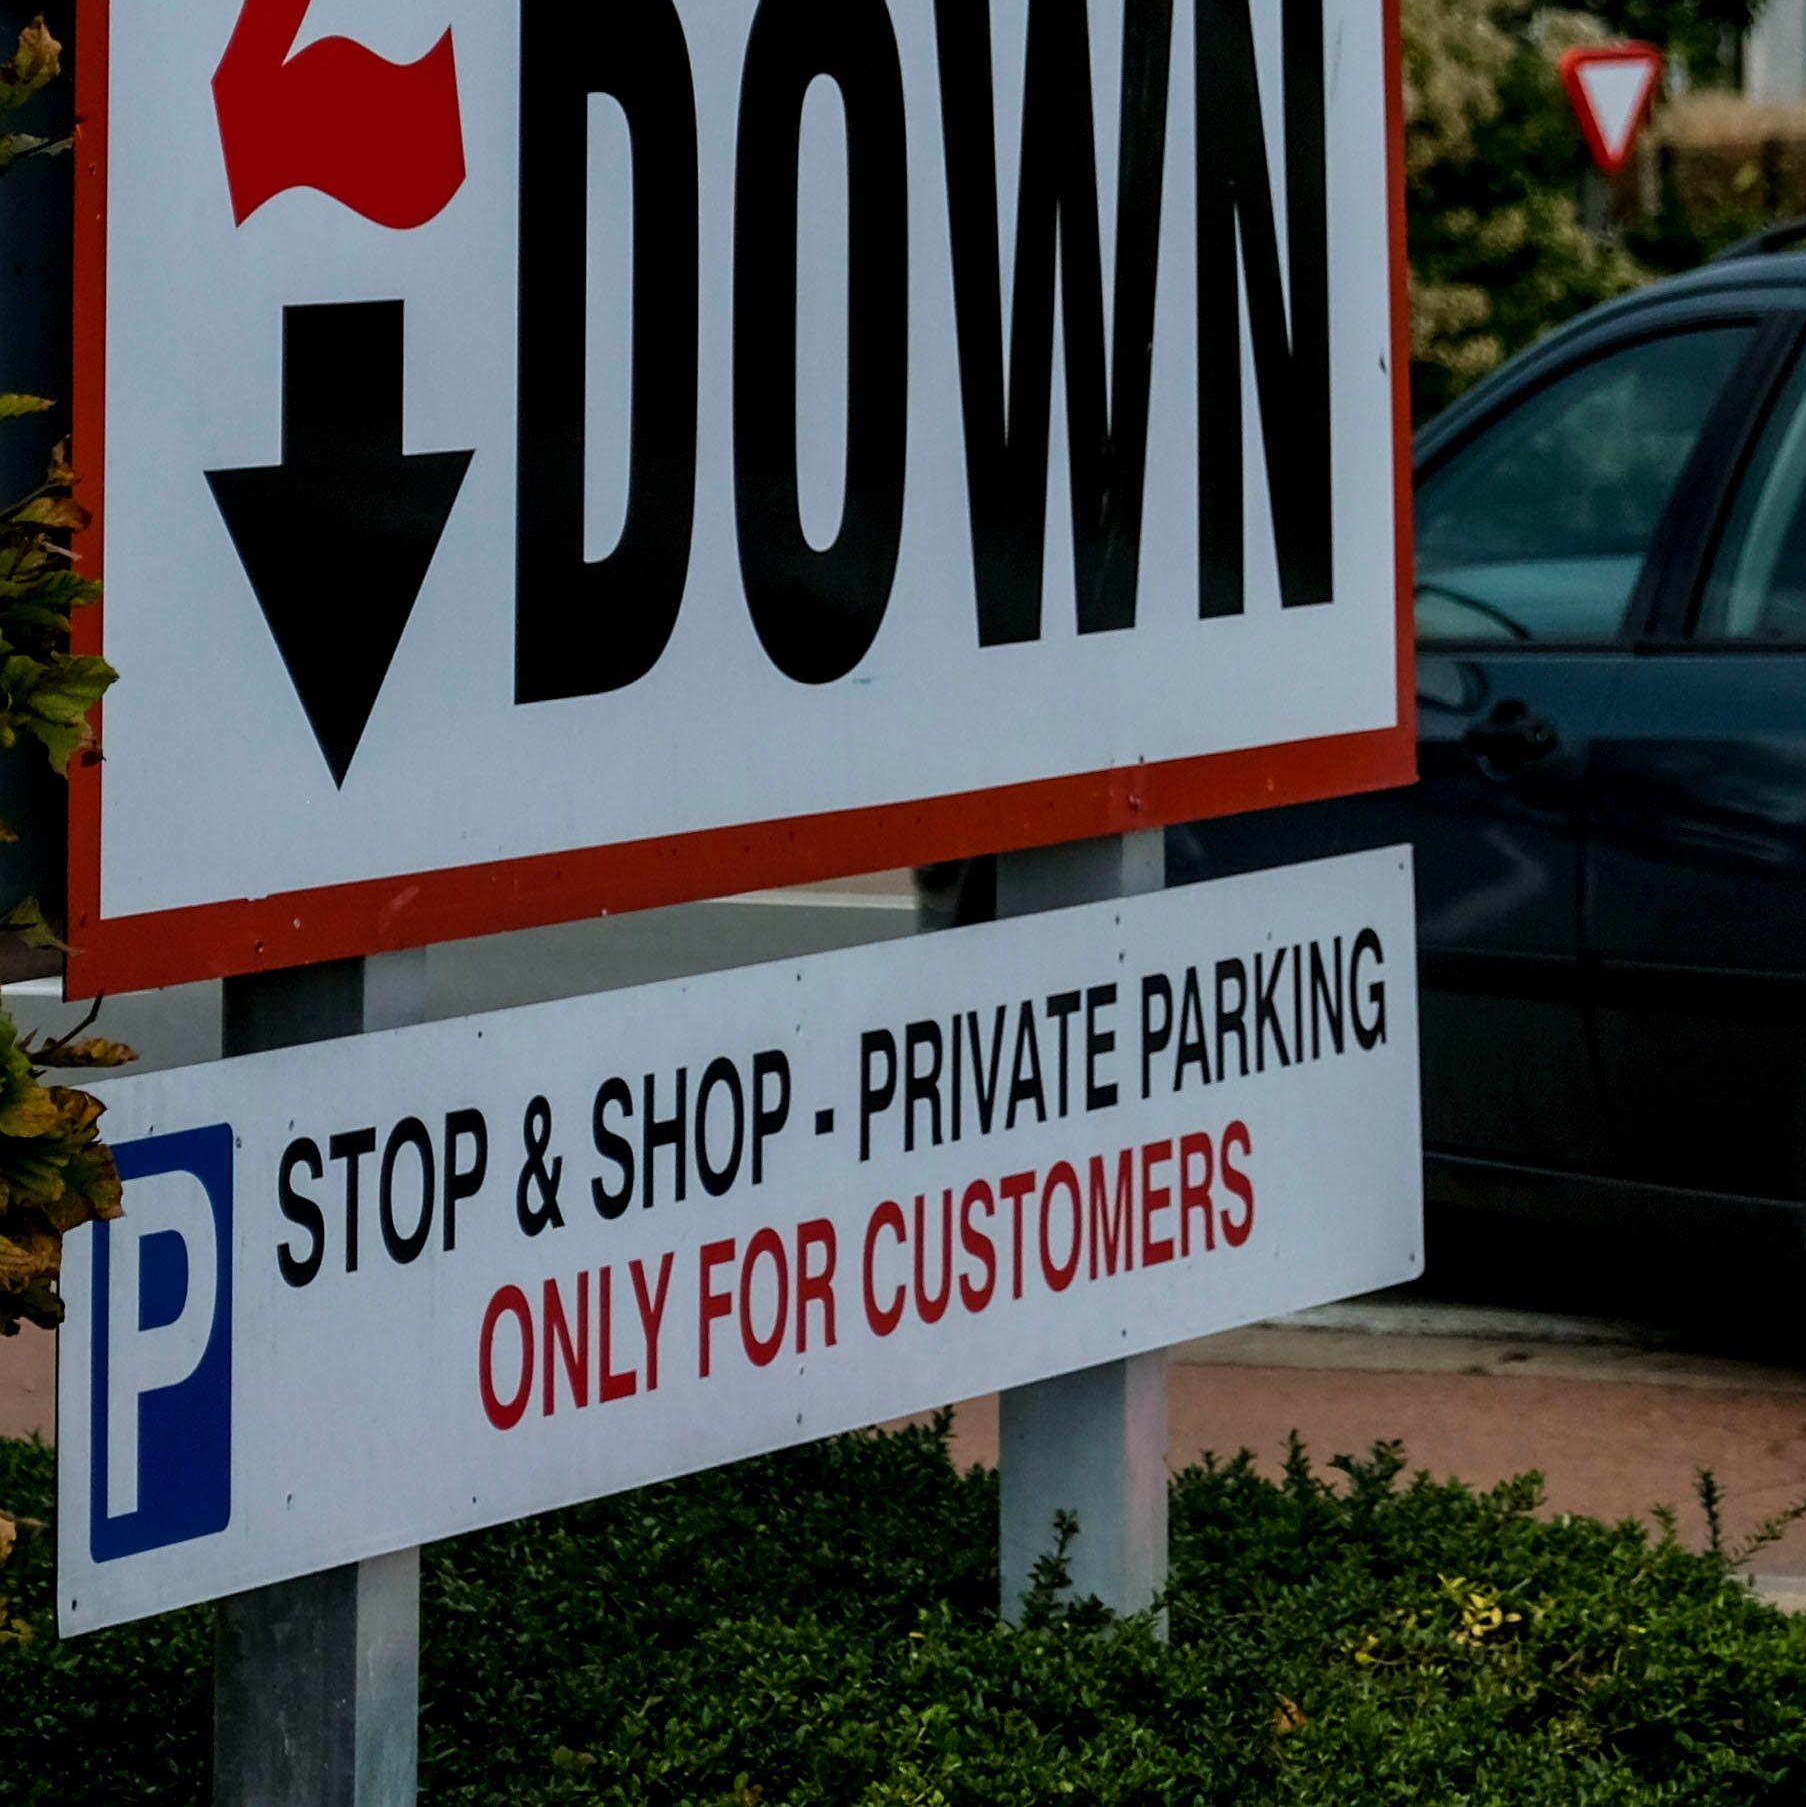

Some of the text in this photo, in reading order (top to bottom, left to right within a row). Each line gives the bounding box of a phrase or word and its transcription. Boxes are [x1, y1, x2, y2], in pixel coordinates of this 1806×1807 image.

[277, 1108, 488, 1287] STOP
[517, 1094, 566, 1237] &
[592, 1050, 792, 1220] SHOP
[860, 983, 1119, 1162] PRIVATE
[1142, 927, 1387, 1099] PARKING
[480, 1121, 1254, 1431] ONLY FOR CUSTOMERS
